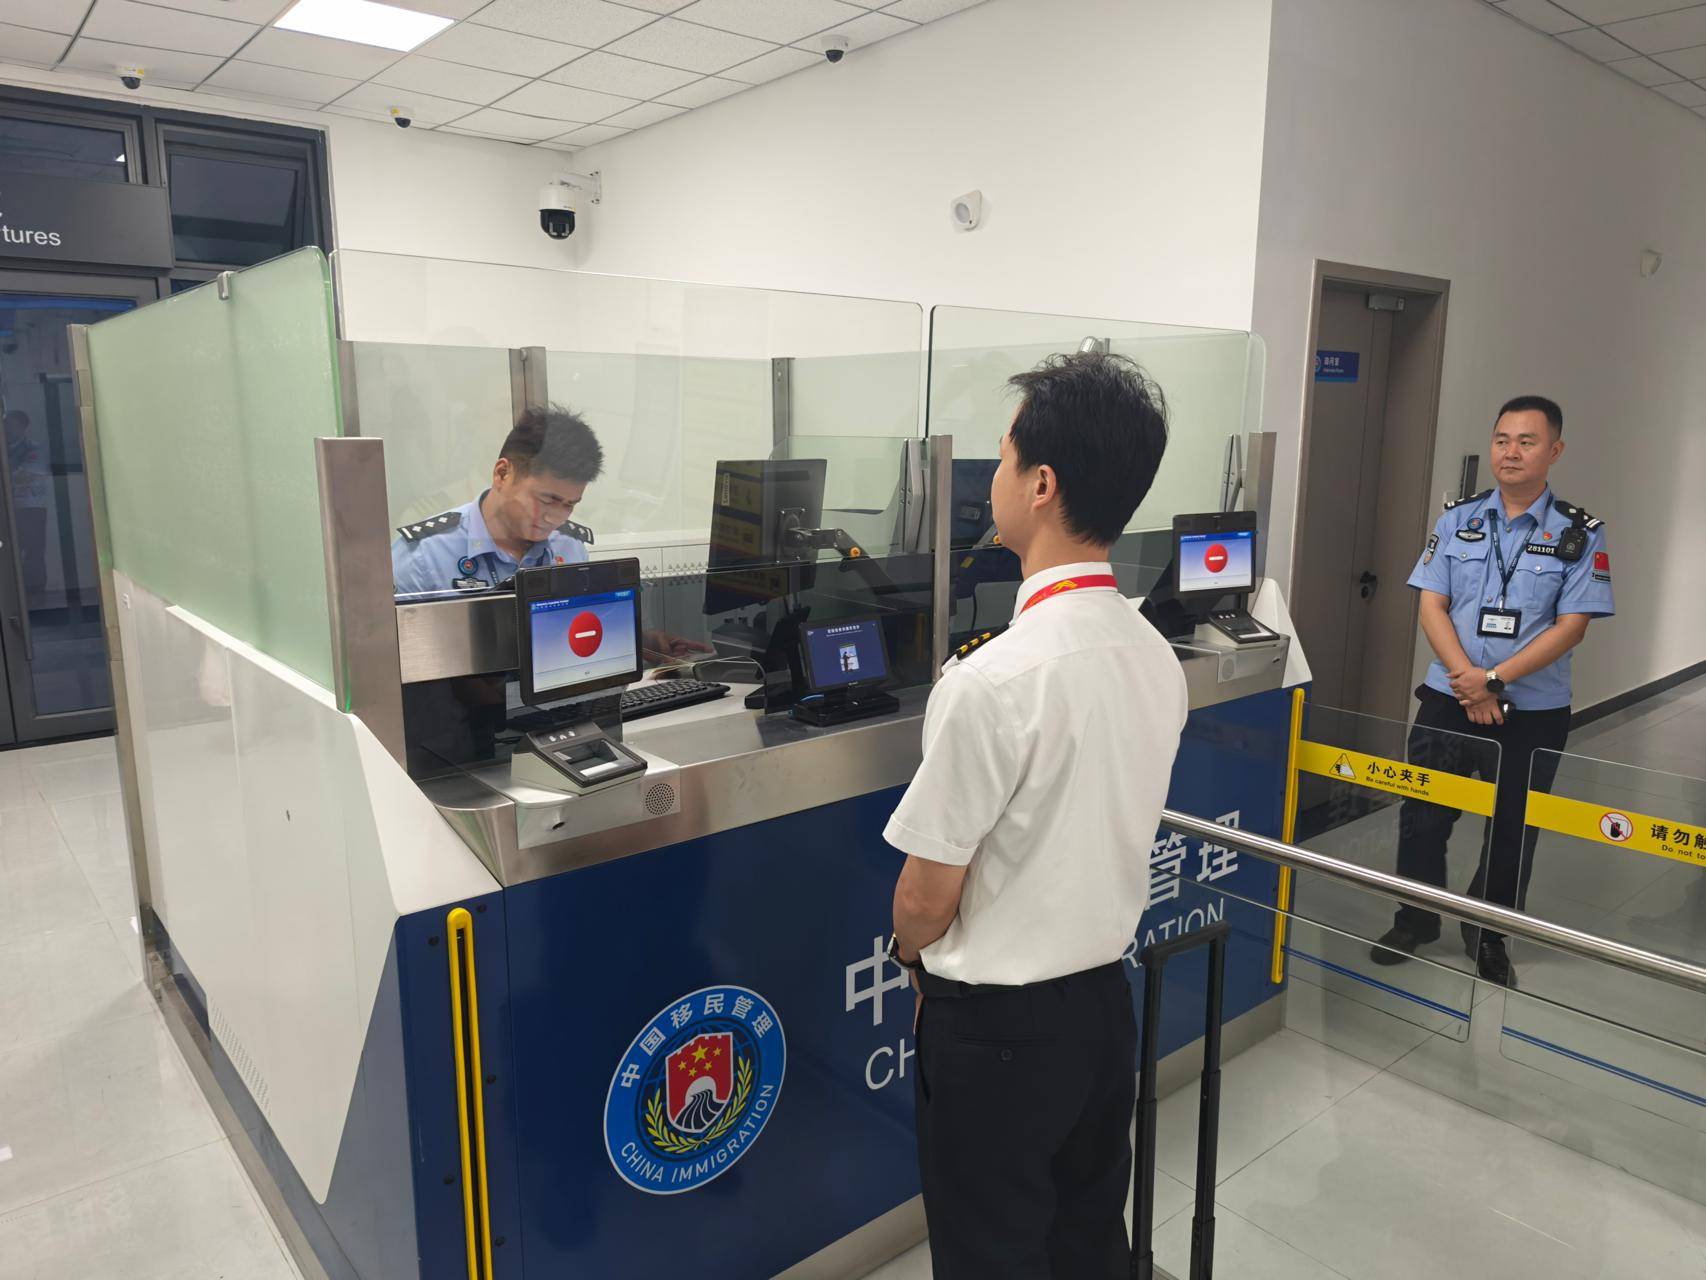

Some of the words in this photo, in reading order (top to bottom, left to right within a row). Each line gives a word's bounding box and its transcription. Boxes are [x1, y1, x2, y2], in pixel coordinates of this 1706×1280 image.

[0, 225, 61, 246] tures
[1367, 762, 1430, 786] 小心夹手
[1375, 779, 1395, 788] careful
[1411, 787, 1429, 796] hands
[1662, 844, 1673, 852] Do
[1678, 849, 1692, 857] not
[621, 993, 773, 1088] 中国移民管理
[621, 1142, 664, 1182] CHINA
[672, 1084, 774, 1183] IMMIGRATION
